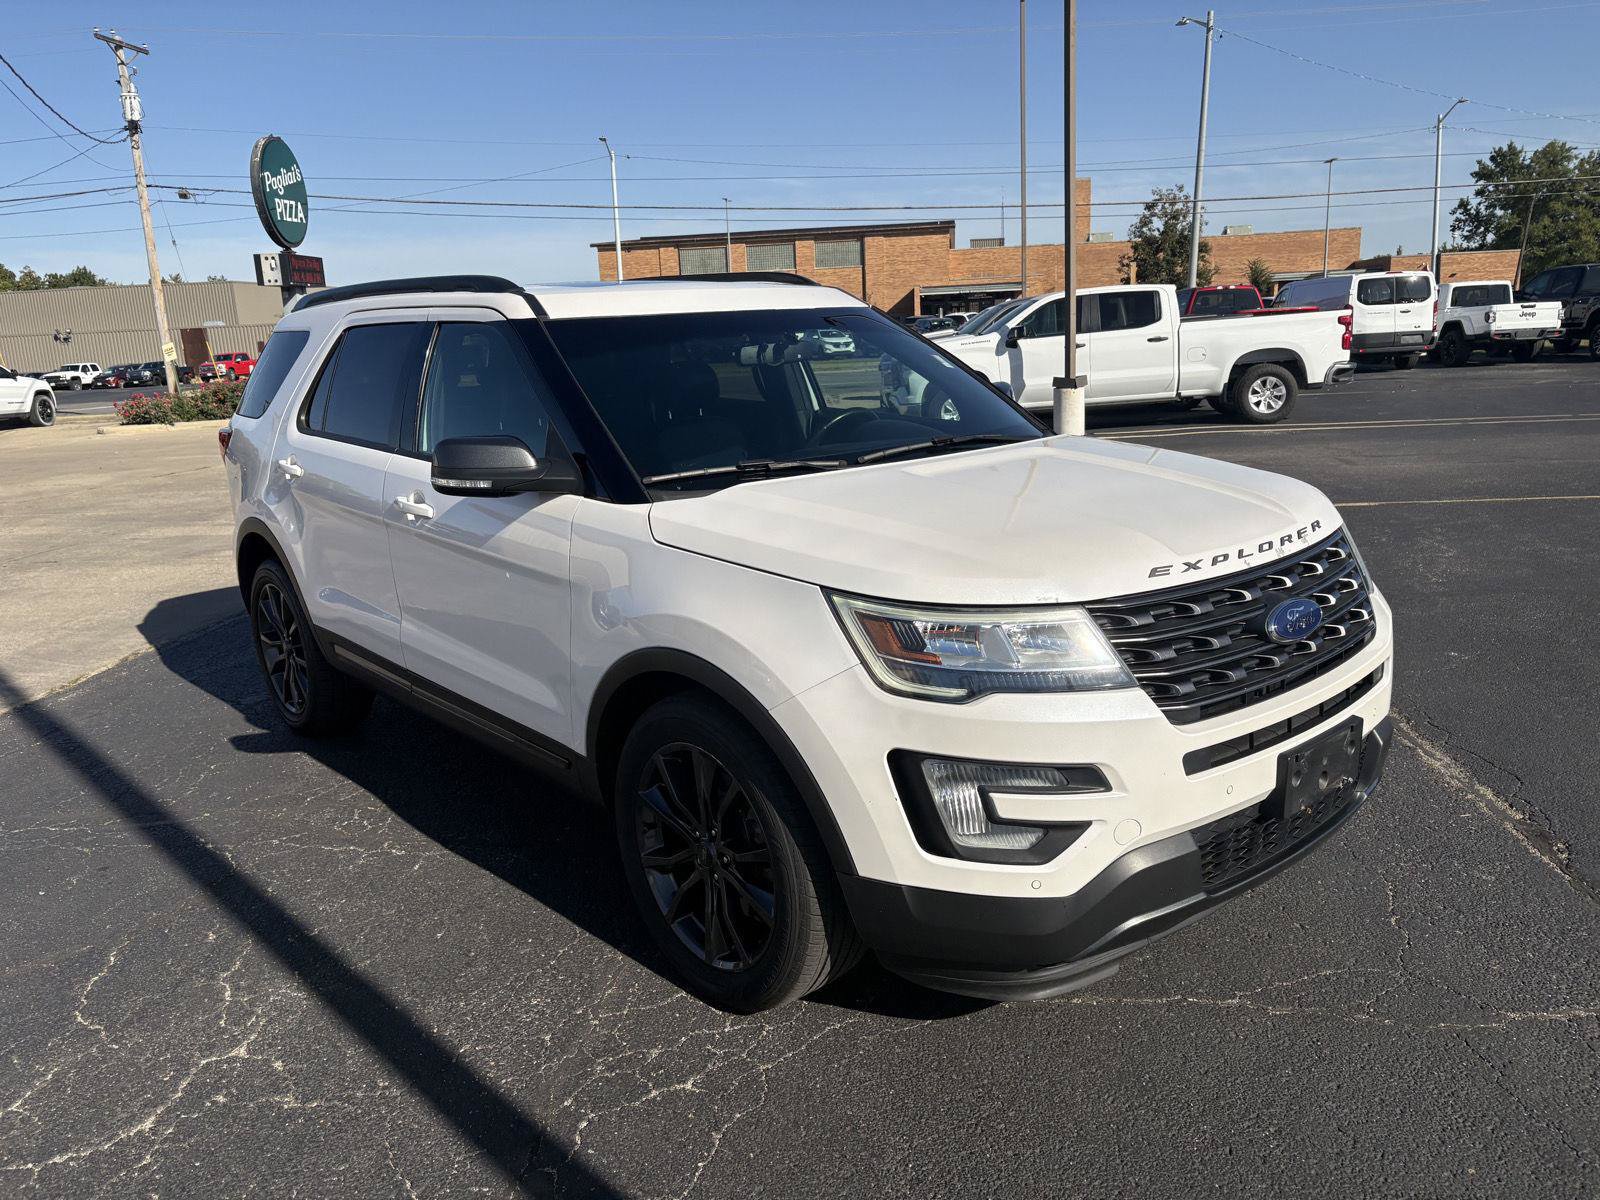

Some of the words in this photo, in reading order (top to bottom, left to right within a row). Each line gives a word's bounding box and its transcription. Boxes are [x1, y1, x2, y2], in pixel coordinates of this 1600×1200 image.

[264, 164, 301, 195] Pagliai's
[274, 198, 306, 223] PIZZA
[1148, 519, 1322, 579] EXPLORER
[1286, 605, 1316, 633] Ford
